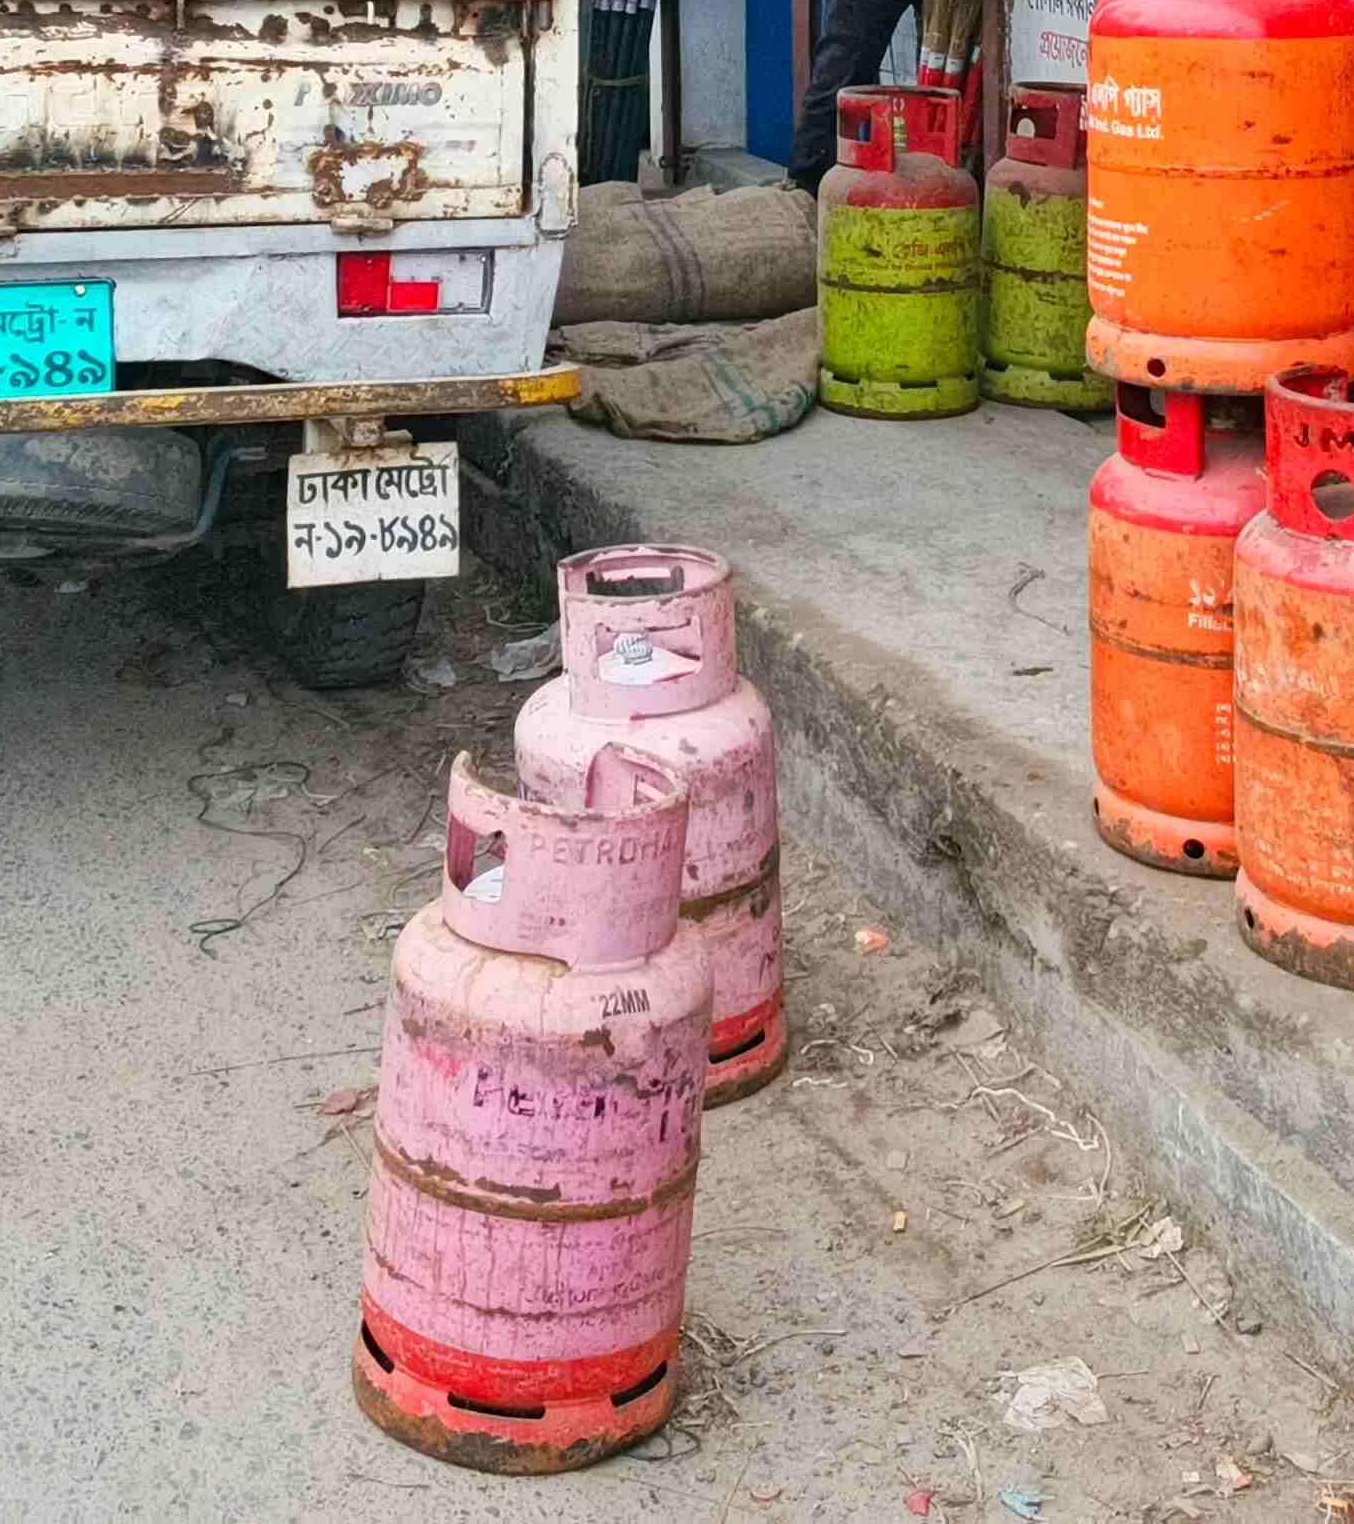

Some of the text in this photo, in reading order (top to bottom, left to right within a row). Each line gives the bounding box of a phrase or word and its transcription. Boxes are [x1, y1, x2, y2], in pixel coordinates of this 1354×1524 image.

[73, 306, 98, 333] ন
[296, 467, 372, 508] ঢাকা
[528, 829, 673, 867] PETROMA
[598, 988, 651, 1018] 22MM
